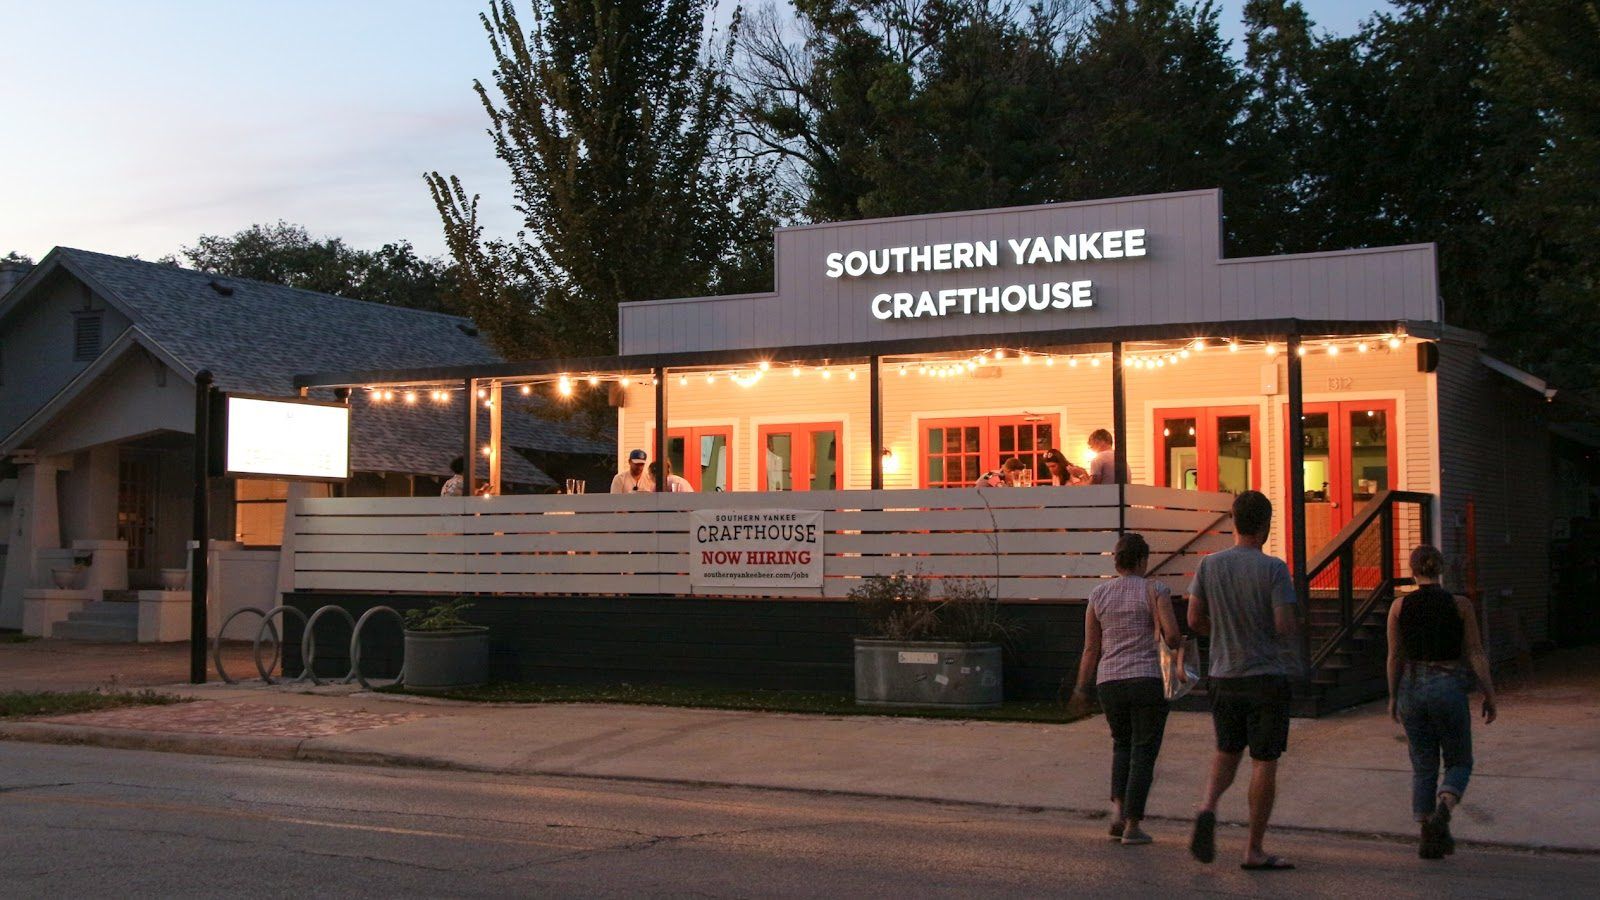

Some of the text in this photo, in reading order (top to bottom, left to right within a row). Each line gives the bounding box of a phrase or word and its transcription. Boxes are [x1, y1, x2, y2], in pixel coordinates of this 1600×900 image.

[827, 229, 1145, 277] SOUTHERN YANKEE
[872, 281, 1092, 319] CRAFTHOUSE
[715, 514, 760, 522] SOUTHERN
[697, 524, 817, 543] CRAFTHOUSE
[701, 551, 811, 565] NOW HIRING
[703, 571, 809, 581] southernyankeebeer.com/jobs
